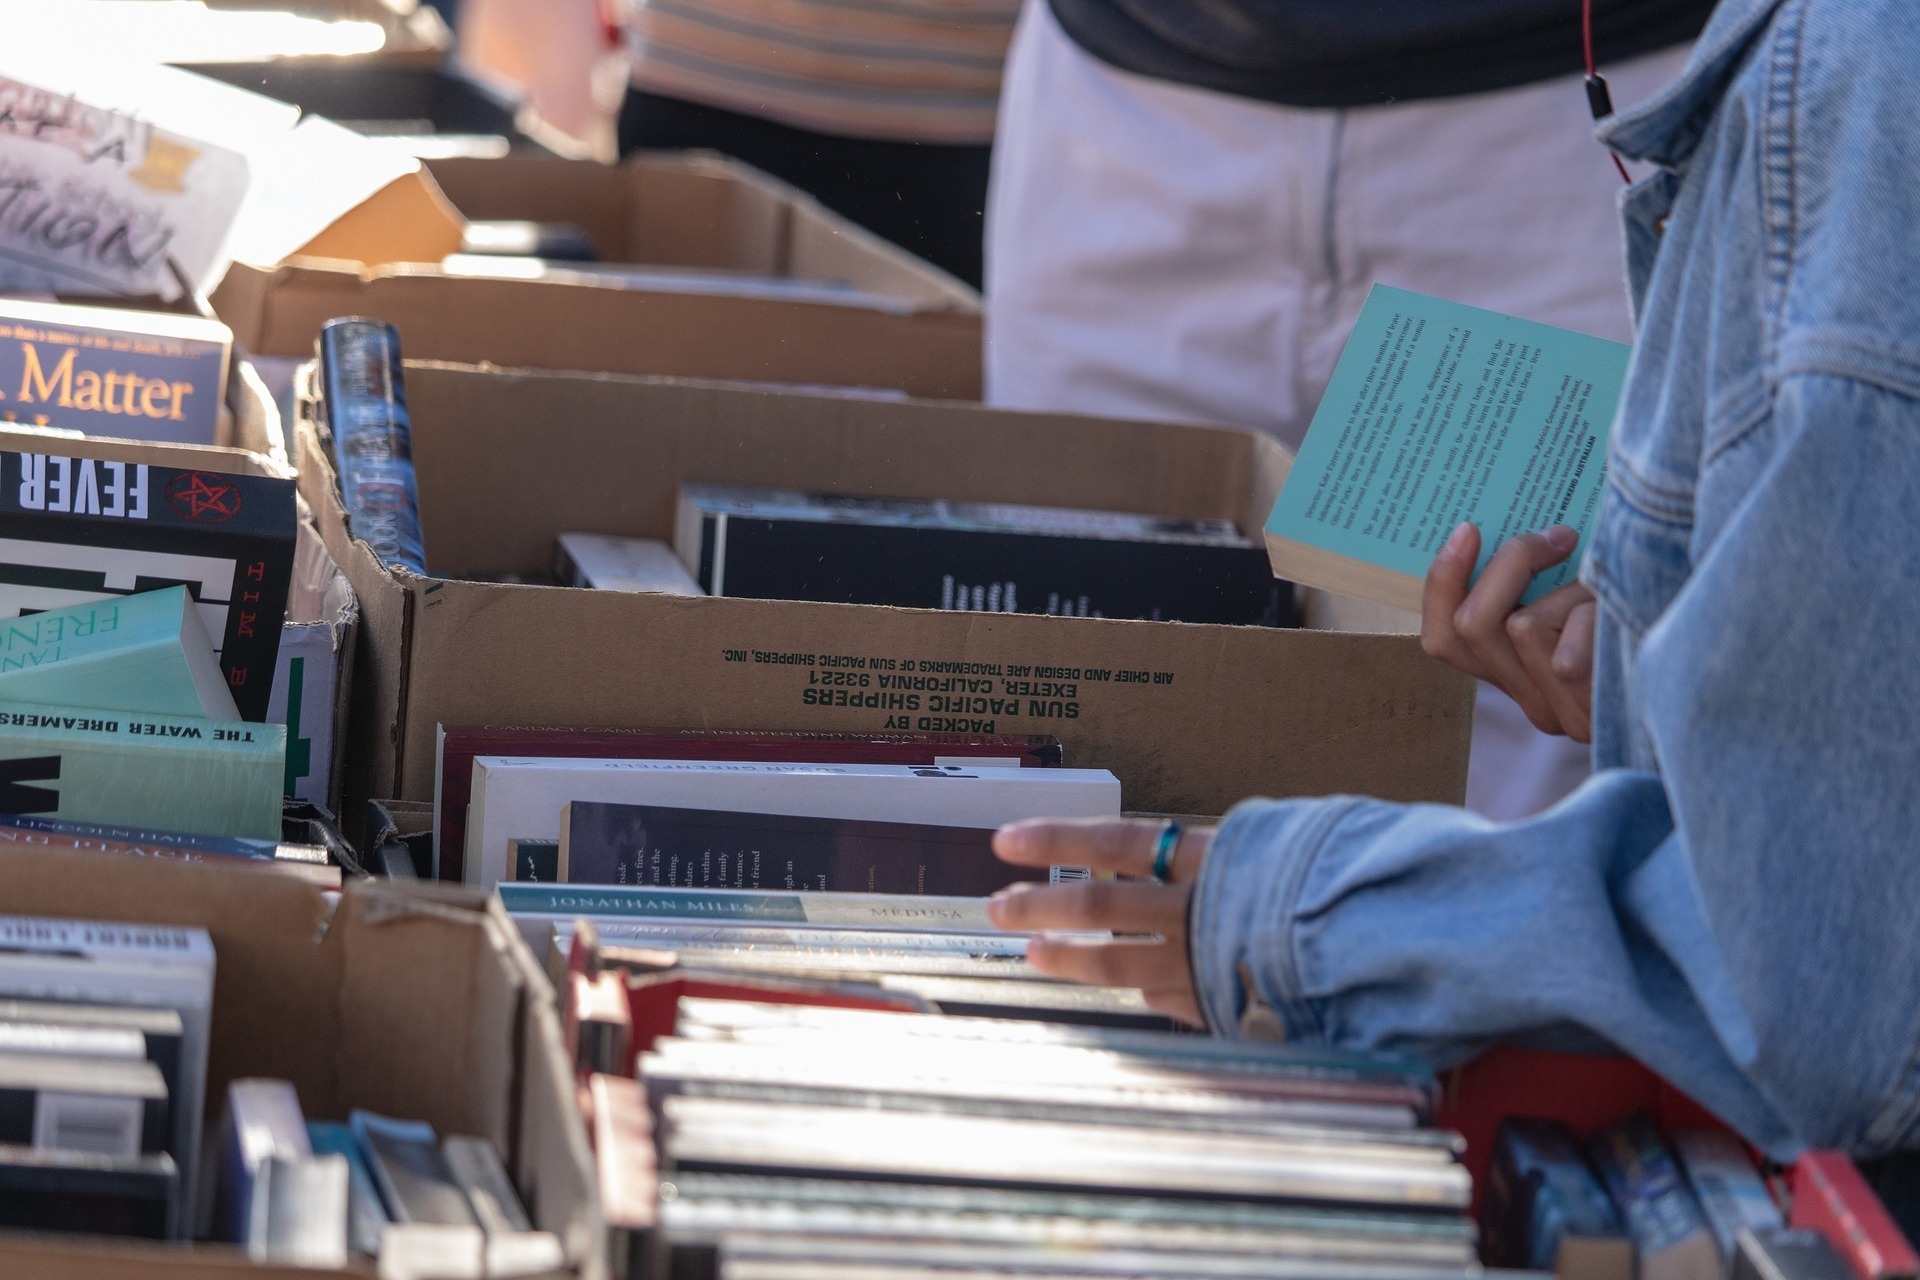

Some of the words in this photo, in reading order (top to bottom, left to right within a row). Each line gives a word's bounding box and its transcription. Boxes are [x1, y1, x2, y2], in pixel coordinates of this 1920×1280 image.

[1365, 365, 1378, 382] three
[1373, 339, 1389, 364] months
[1388, 312, 1401, 329] leave
[1380, 351, 1398, 380] homicide
[1394, 316, 1414, 350] newcomer,
[1385, 359, 1409, 401] investigation
[1412, 319, 1426, 342] woman
[1435, 383, 1448, 400] Mark
[1442, 358, 1461, 383] Dobbie,
[1456, 329, 1472, 352] steroid
[1471, 383, 1486, 401] body
[1480, 368, 1491, 381] and
[1486, 352, 1498, 365] find
[1493, 338, 1504, 349] the
[17, 341, 195, 421] Matter
[1419, 393, 1430, 403] the
[1425, 344, 1453, 390] disappearance
[1476, 404, 1490, 423] burnt
[1488, 376, 1502, 395] death
[1500, 357, 1510, 367] his
[1505, 341, 1517, 356] bed.
[1492, 405, 1504, 418] and
[1498, 388, 1511, 404] Kate
[1505, 360, 1523, 387] Farrer's
[1517, 344, 1531, 359] past
[1449, 380, 1464, 401] sister.
[1504, 406, 1517, 423] must
[1512, 389, 1526, 405] fight
[1519, 370, 1532, 388] them
[1529, 347, 1542, 363] lives
[20, 454, 149, 520] FEVER
[1553, 511, 1564, 525] THE
[1559, 478, 1578, 510] WEEKEND
[1573, 435, 1596, 477] AUSTRALIAN
[371, 512, 401, 564] OOK
[237, 562, 265, 638] TIM
[0, 606, 119, 651] FREN
[722, 649, 747, 664] INC.
[751, 649, 815, 668] SHIPPERS,
[819, 655, 866, 670] PACIFIC
[869, 657, 896, 672] SUN
[900, 659, 915, 673] OF
[919, 660, 1003, 677] TRADEMARKS
[1007, 664, 1031, 679] ARE
[1035, 666, 1081, 681] DESIGN
[1085, 668, 1111, 682] AND
[1115, 670, 1150, 684] CHIEF
[1154, 671, 1174, 685] AIR
[809, 670, 870, 687] 93221
[878, 674, 994, 694] CALIFORNIA
[1001, 677, 1079, 697] EXETER,
[803, 688, 921, 710] SHIPPERS
[928, 694, 1020, 716] PACIFIC
[1029, 700, 1080, 719] SUN
[0, 714, 119, 733] DREAMERS
[129, 723, 202, 739] WATER
[883, 714, 910, 730] BY
[916, 716, 996, 734] PACKED
[213, 729, 255, 743] THE
[712, 729, 843, 739] INDEPENDENT
[604, 762, 756, 771] GREENFIELD
[767, 765, 847, 773] SUSAN
[635, 847, 644, 868] fires.
[652, 848, 661, 864] the
[701, 849, 711, 882] within.
[751, 850, 761, 879] friend
[652, 866, 661, 883] and
[668, 853, 679, 887] othing.
[685, 861, 694, 888] ulates
[718, 852, 729, 881] family
[734, 850, 744, 890] olerance.
[785, 860, 794, 872] an
[550, 895, 677, 910] JONATHAN
[687, 900, 754, 912] MILES
[870, 907, 964, 920] MEDUSA
[946, 936, 1005, 949] BERG
